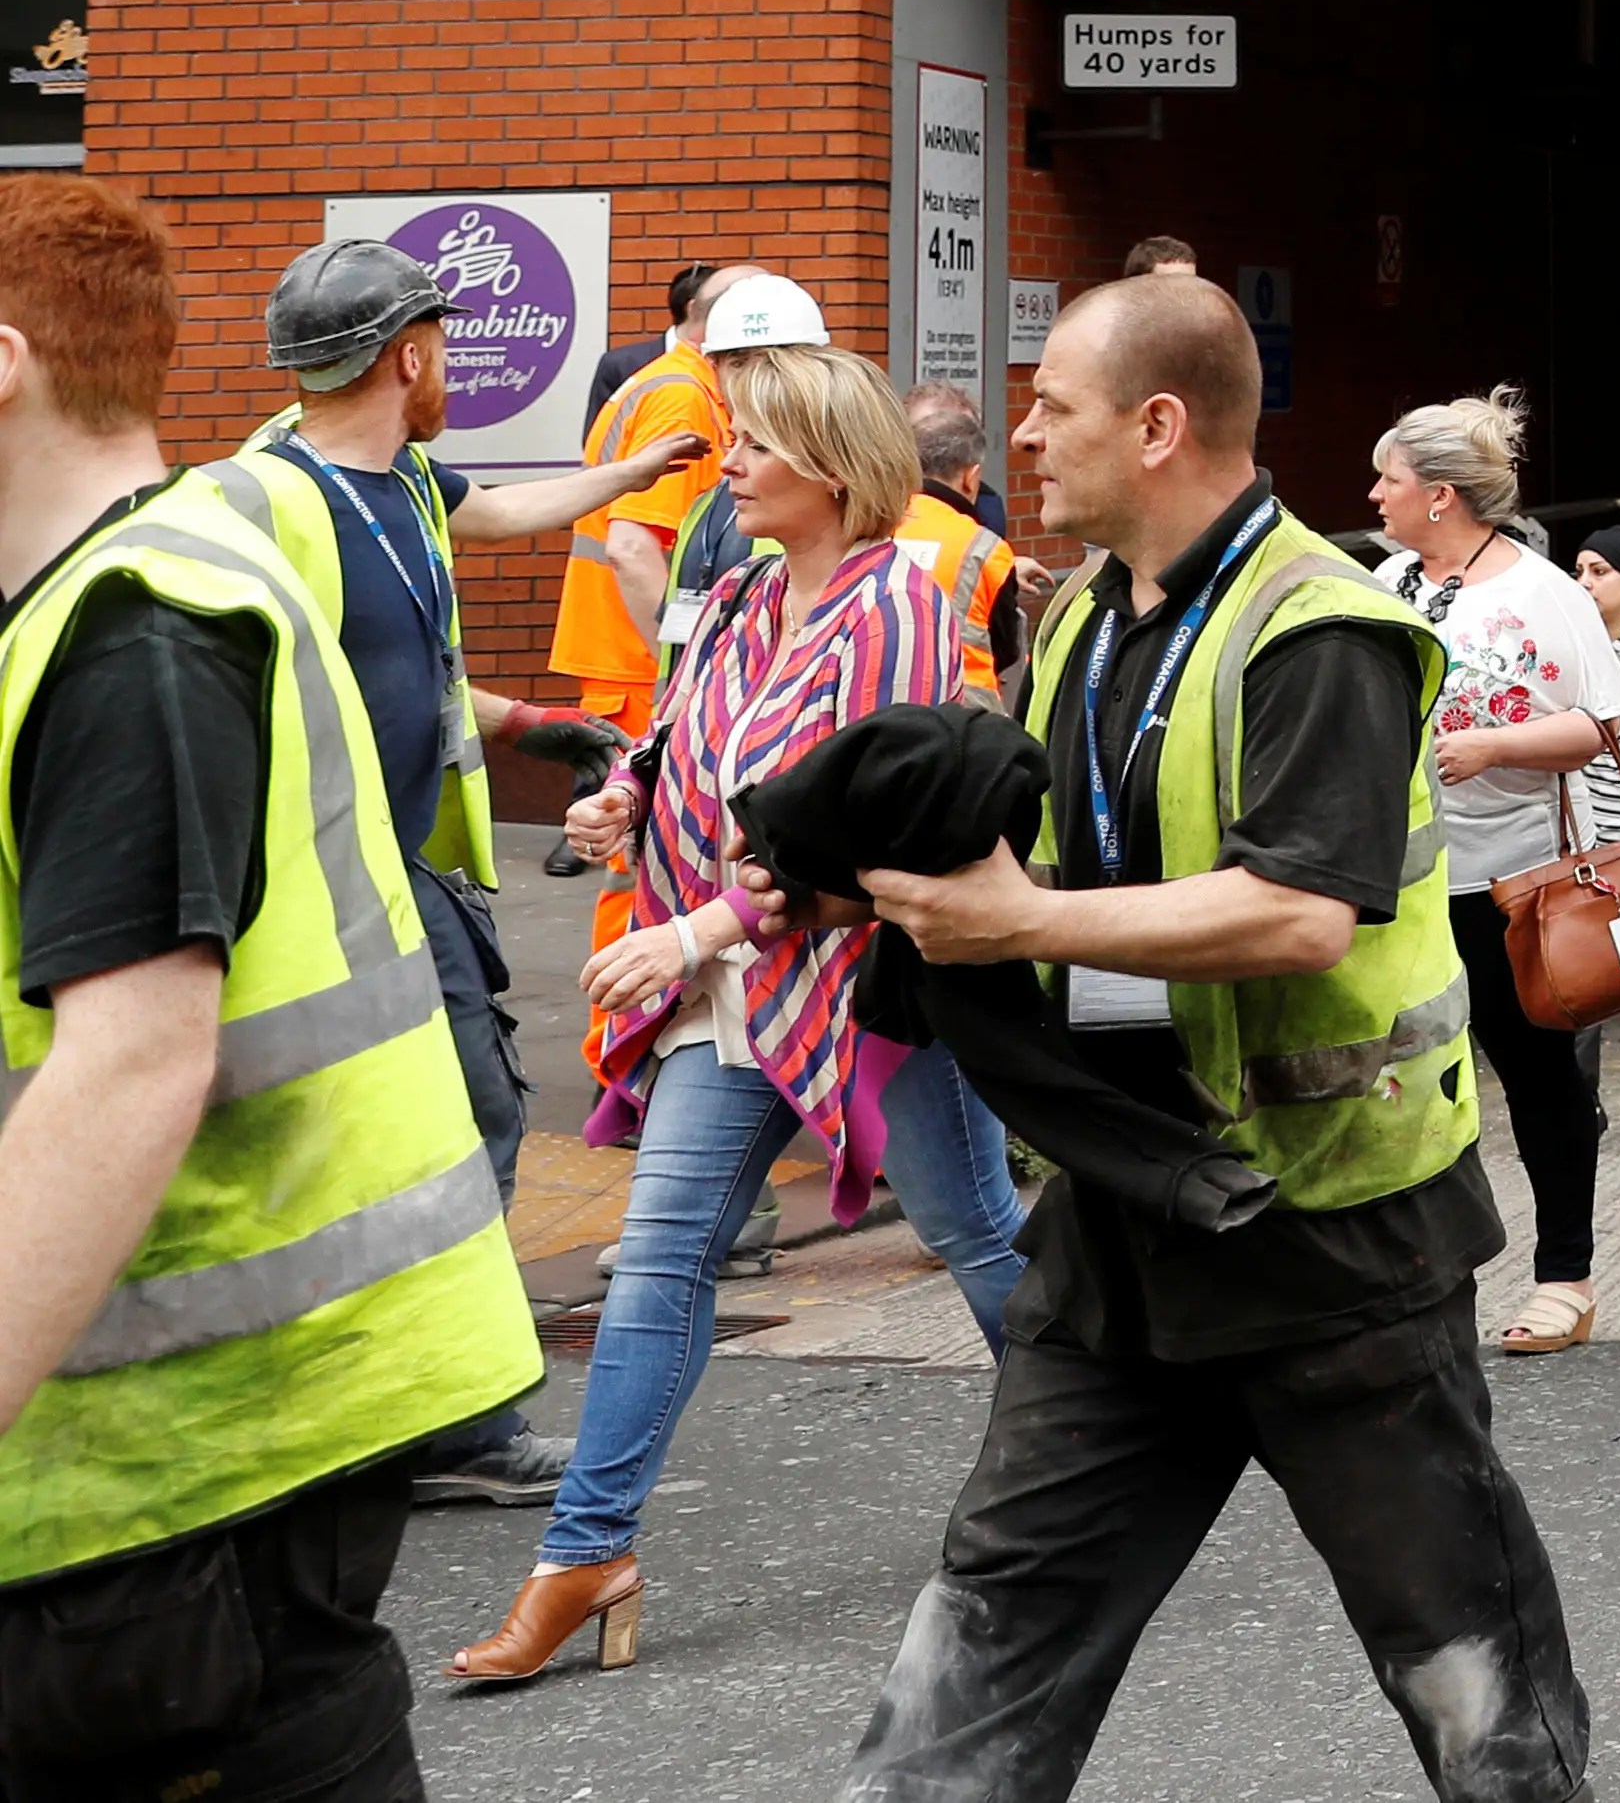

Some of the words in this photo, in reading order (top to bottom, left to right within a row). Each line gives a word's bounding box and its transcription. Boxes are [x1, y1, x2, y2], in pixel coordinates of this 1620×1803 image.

[1075, 23, 1173, 48] Humps
[1186, 25, 1226, 45] for
[1084, 52, 1125, 74] 40
[1139, 53, 1217, 78] yards
[923, 123, 980, 156] WARNING
[923, 189, 946, 212] Max
[947, 191, 980, 220] height
[928, 226, 974, 271] 4.1m
[742, 326, 770, 338] TMT
[331, 472, 376, 525] CONTRACTOR
[1144, 625, 1192, 711] CONTRACTOR
